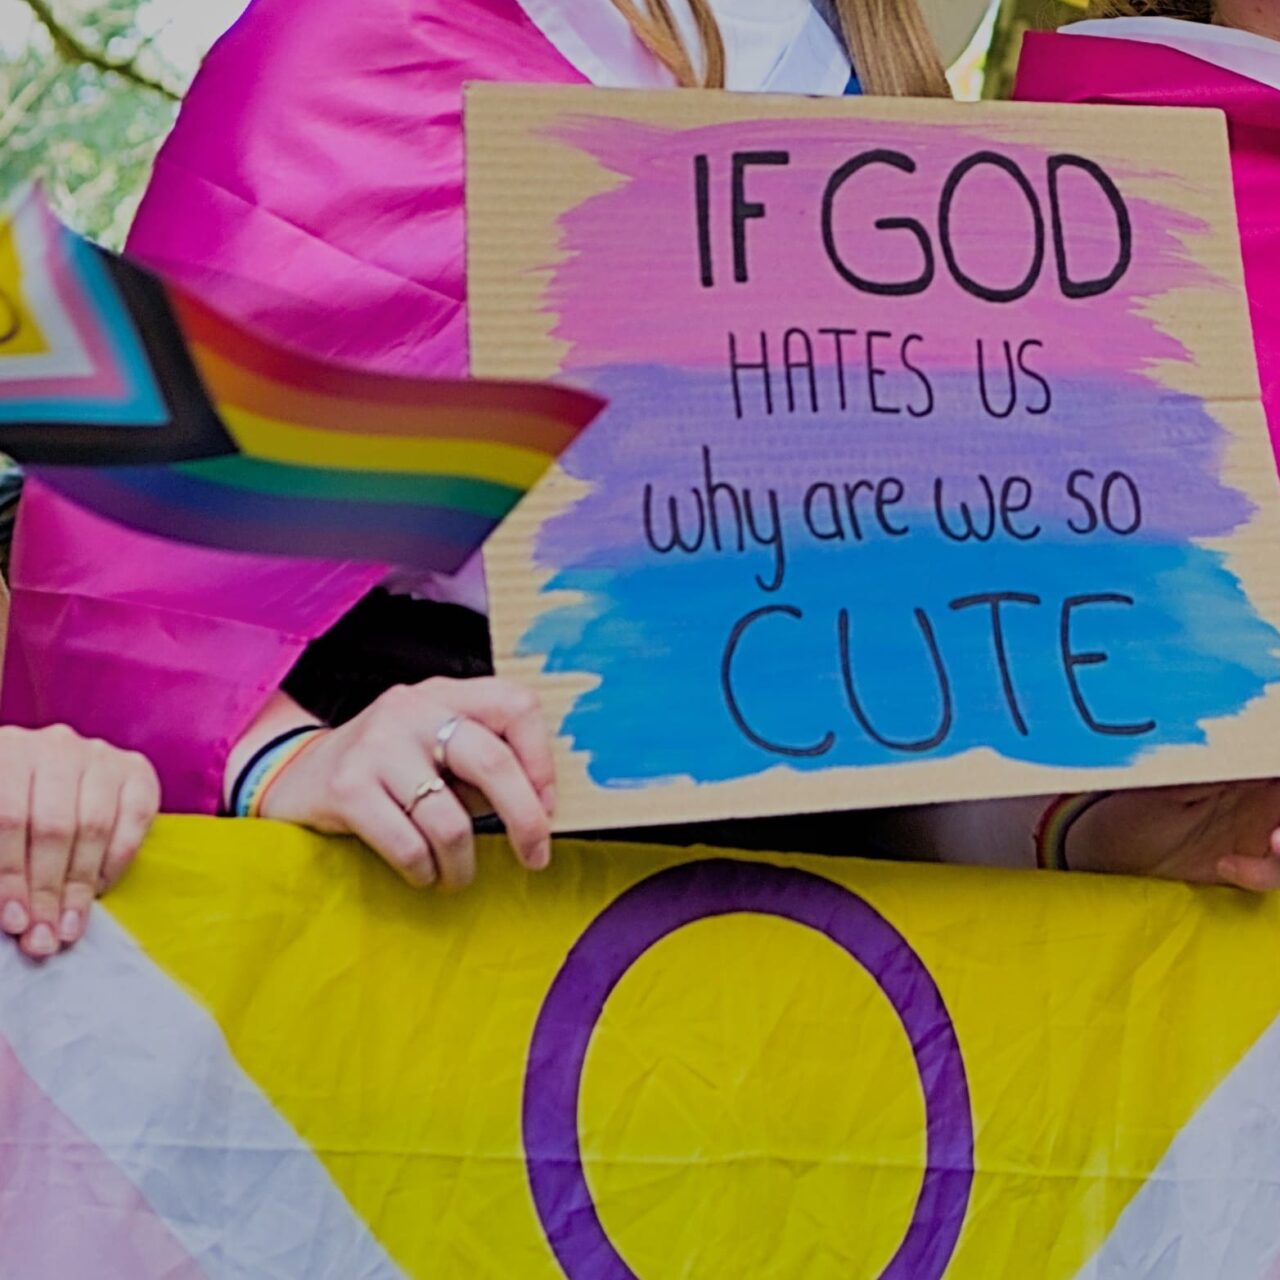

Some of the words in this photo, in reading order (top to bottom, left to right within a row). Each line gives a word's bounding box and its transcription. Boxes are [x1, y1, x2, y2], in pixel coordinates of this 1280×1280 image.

[694, 150, 790, 288] IF
[821, 149, 1132, 303] GOD
[727, 327, 934, 418] HATES
[976, 338, 1052, 418] US
[642, 445, 785, 592] why
[803, 475, 906, 542] are
[933, 474, 1035, 541] we
[1066, 469, 1142, 536] so
[721, 591, 1156, 756] CUTE
